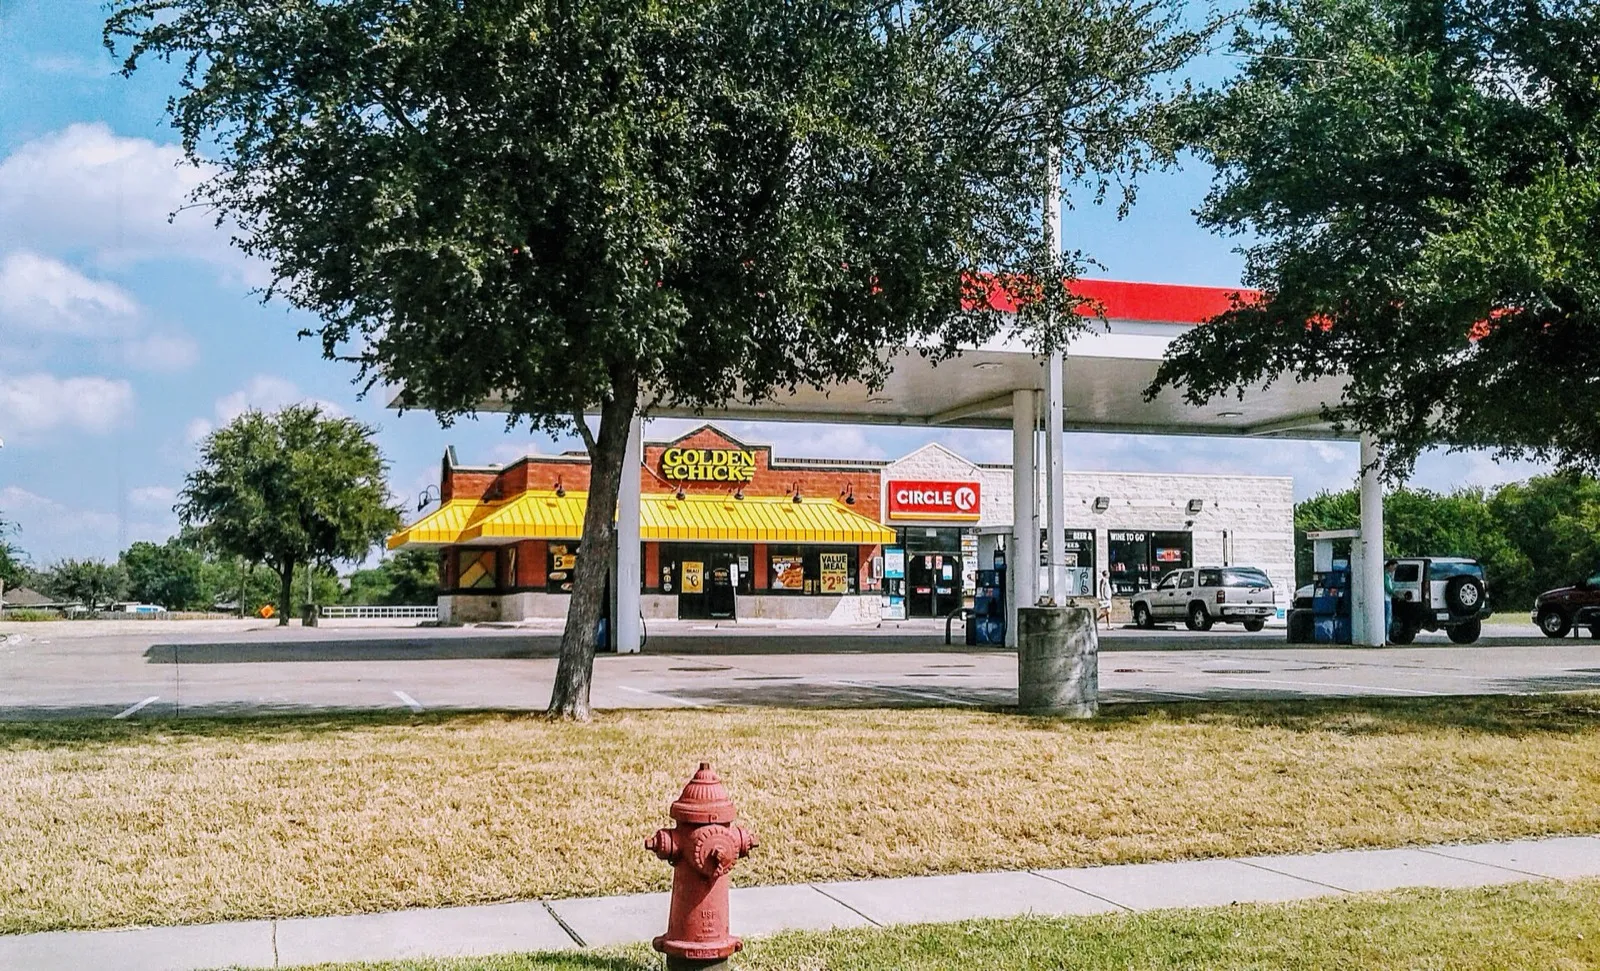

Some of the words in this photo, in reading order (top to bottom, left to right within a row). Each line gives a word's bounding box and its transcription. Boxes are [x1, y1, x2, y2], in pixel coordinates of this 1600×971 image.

[664, 448, 756, 466] GOLDEN
[673, 465, 746, 481] CHICK
[897, 490, 952, 505] CIRCLE
[957, 489, 974, 508] K
[1110, 531, 1126, 541] WINE
[1126, 532, 1134, 542] TO
[1135, 533, 1145, 542] GO
[555, 557, 563, 567] 5
[821, 555, 847, 563] VALUE
[823, 562, 846, 570] MEAL
